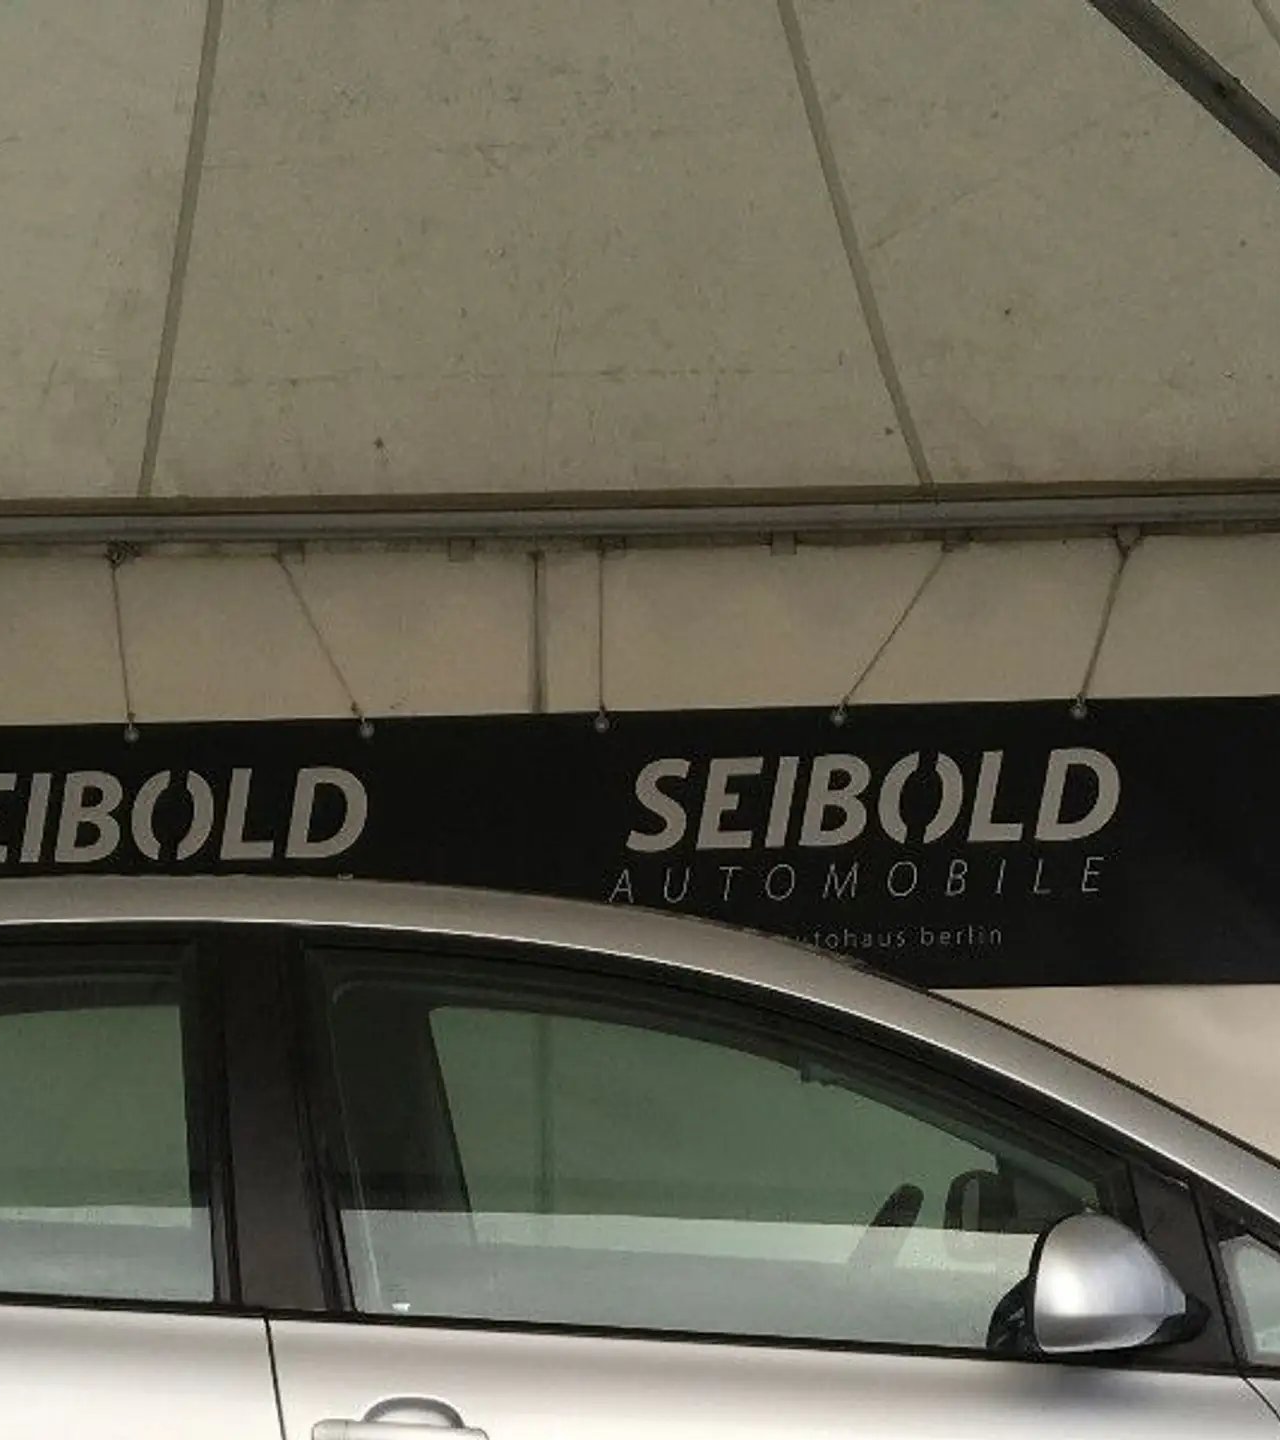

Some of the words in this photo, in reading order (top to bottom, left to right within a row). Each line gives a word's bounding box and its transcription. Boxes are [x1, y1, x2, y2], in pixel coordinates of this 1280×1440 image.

[626, 748, 1121, 853] SEIBOLD
[609, 857, 1105, 903] AUTOMOBILE
[920, 924, 1003, 947] berlin
